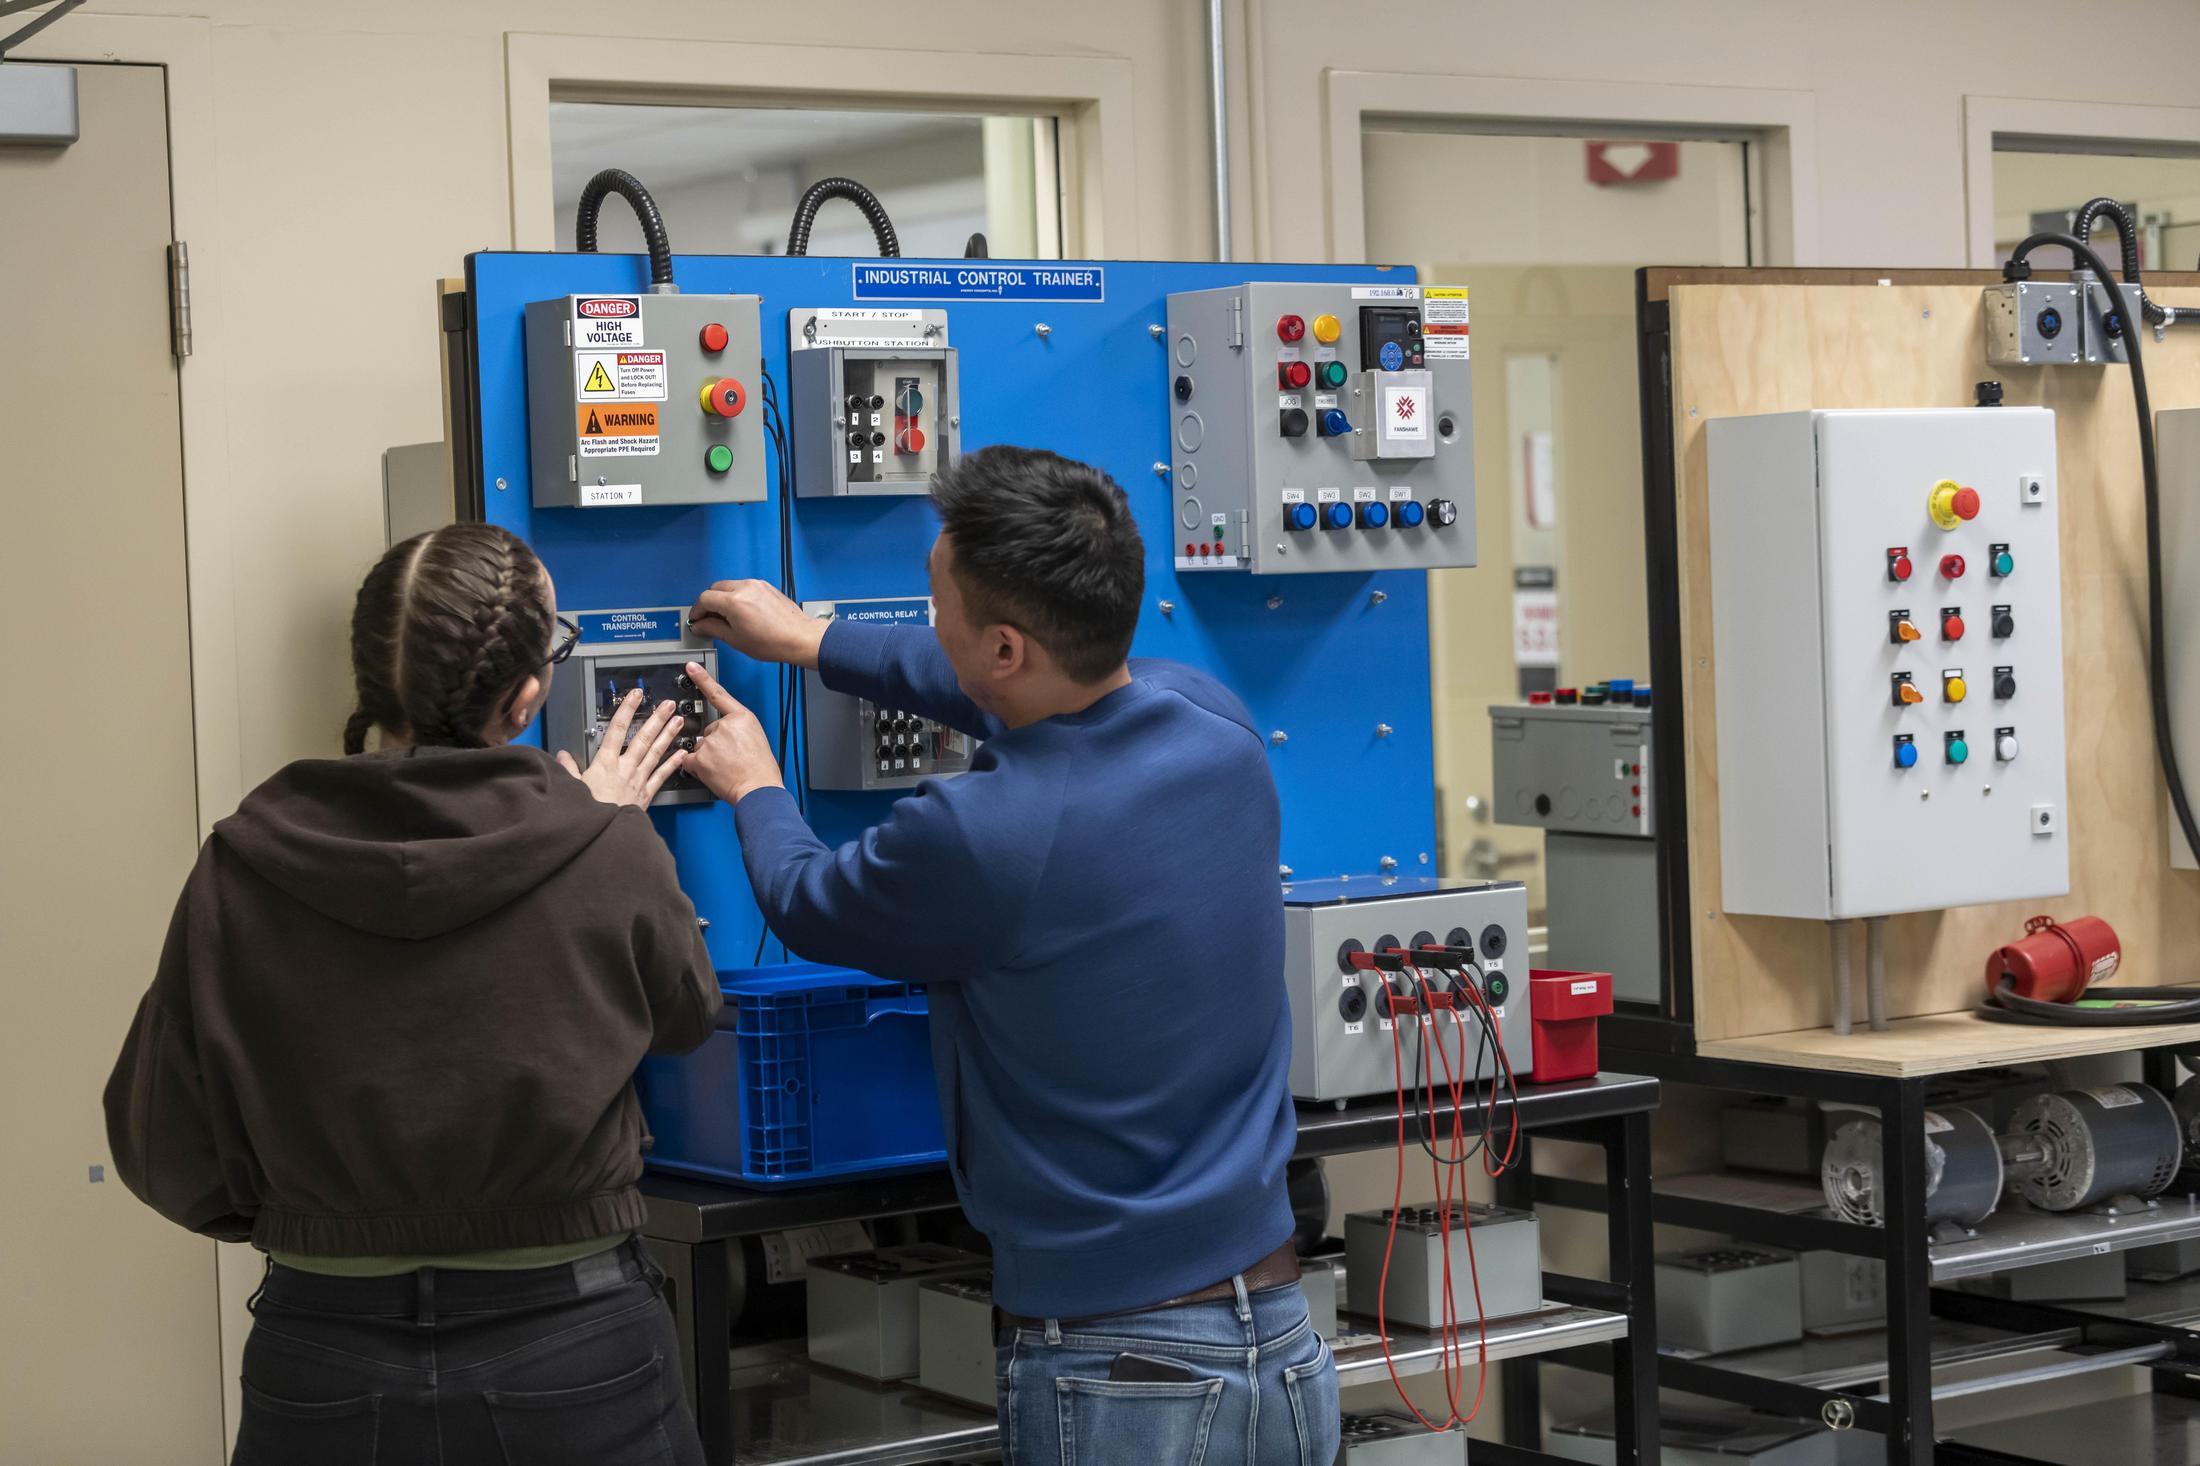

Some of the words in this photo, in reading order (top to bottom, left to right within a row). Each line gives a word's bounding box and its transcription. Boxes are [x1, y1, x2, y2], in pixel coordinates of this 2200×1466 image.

[865, 270, 951, 285] INDUSTRIAL
[958, 271, 1026, 286] CONTROL
[1033, 272, 1093, 286] TRAINER
[585, 303, 631, 314] DANGER
[596, 321, 622, 331] HIGH
[587, 333, 632, 342] VOLTAGE
[627, 355, 661, 363] DANGER
[604, 413, 655, 426] WARNING
[584, 446, 617, 454] Appropriate
[630, 445, 656, 453] Required
[590, 492, 623, 500] STATION
[1286, 492, 1300, 500] SW4
[1394, 490, 1407, 498] SW1
[611, 614, 647, 622] CONTROL
[859, 611, 894, 620] CONTROL
[895, 610, 918, 618] RELAY
[601, 621, 657, 631] TRANSFORMER
